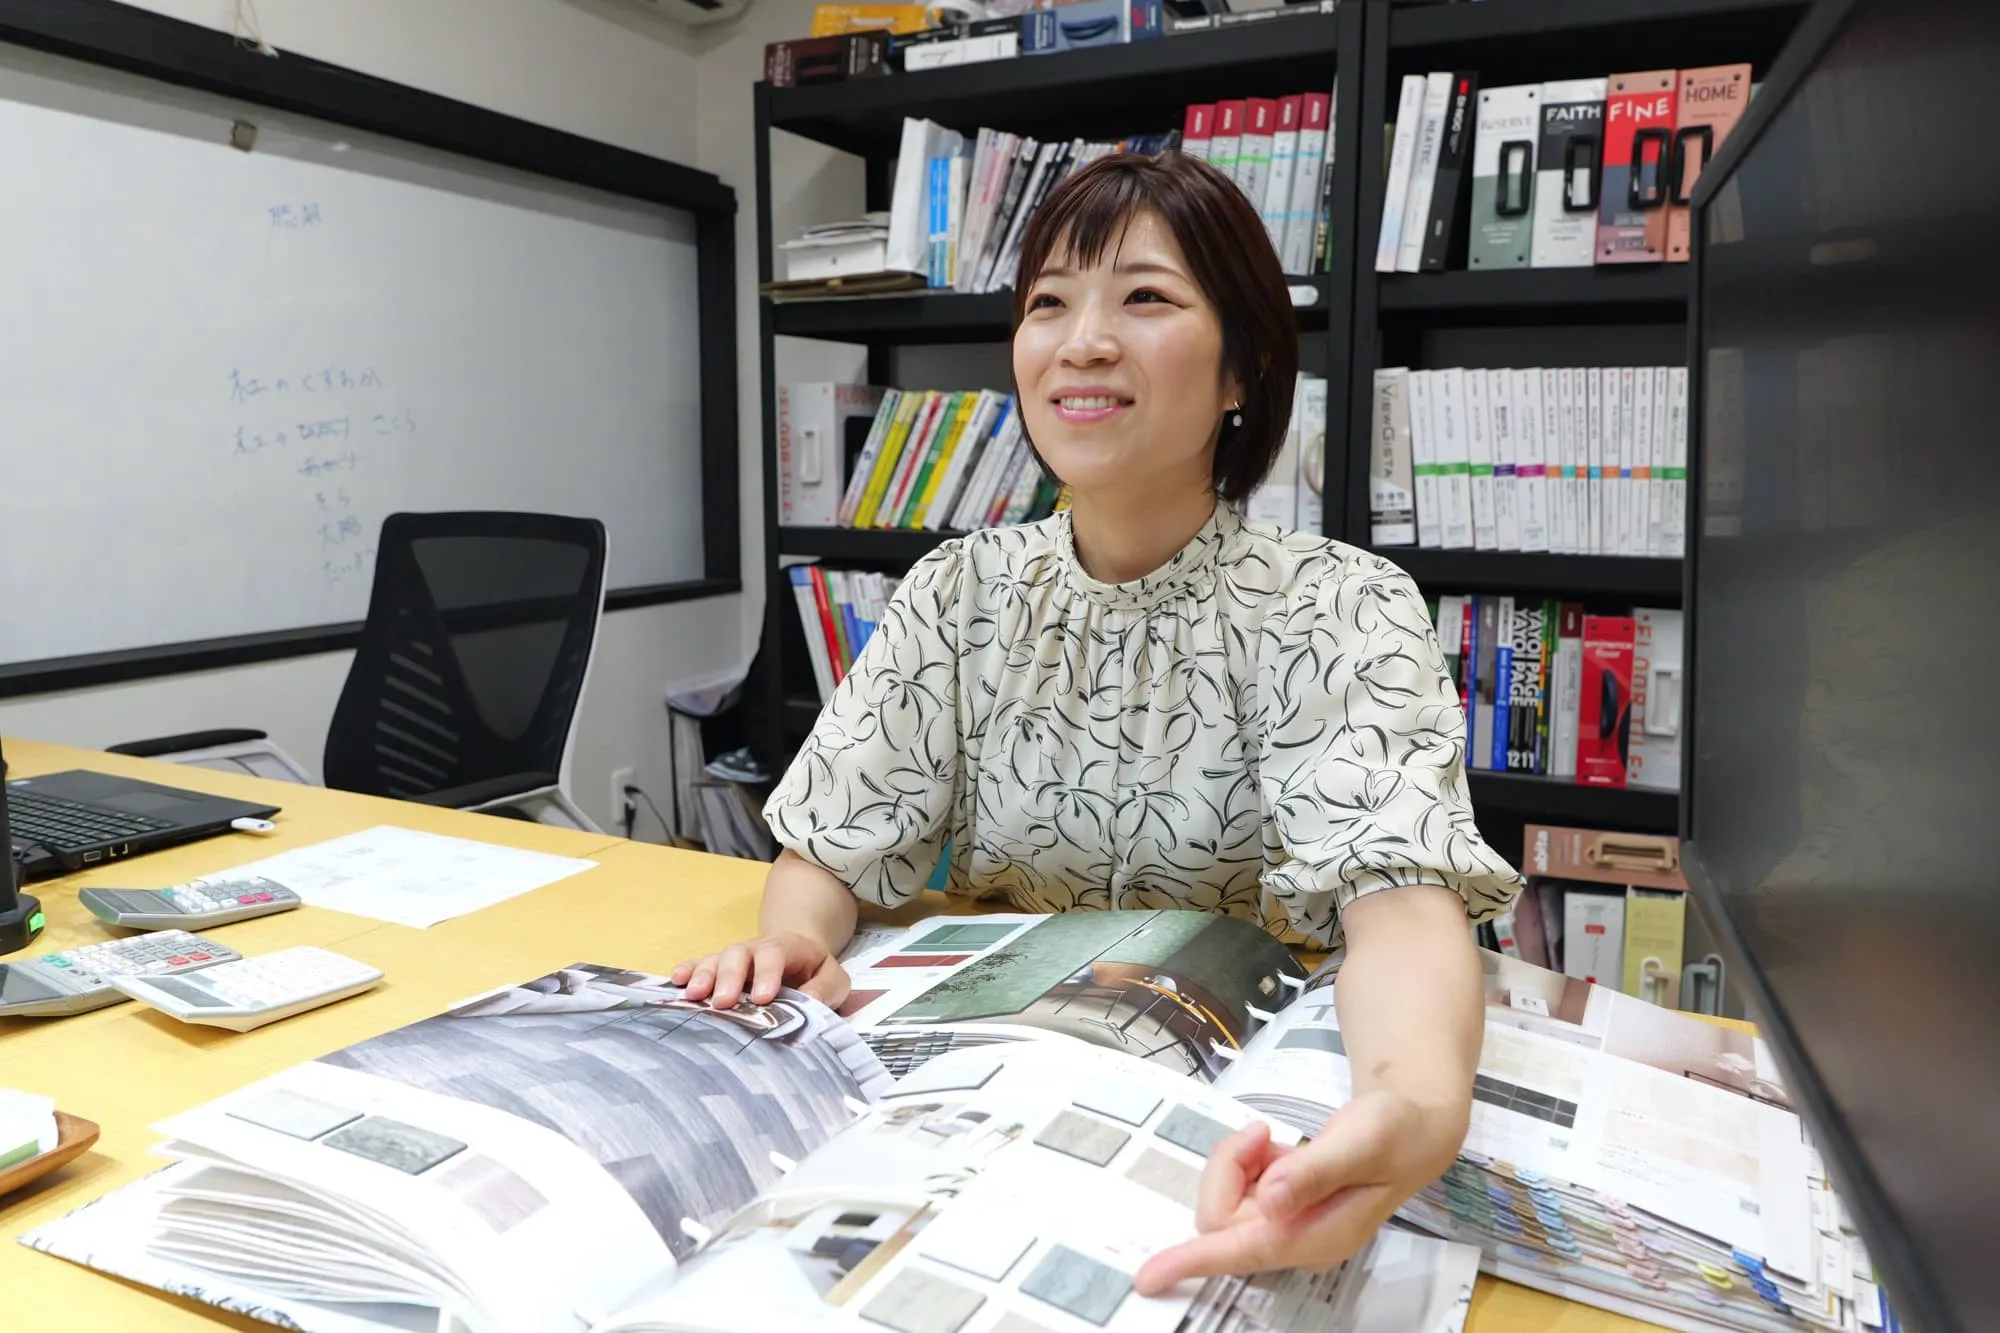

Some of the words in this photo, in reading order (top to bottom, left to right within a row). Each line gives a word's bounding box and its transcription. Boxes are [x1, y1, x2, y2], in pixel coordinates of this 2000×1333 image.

[1546, 105, 1601, 121] FAITH
[1608, 97, 1671, 122] FINE
[1685, 83, 1739, 103] HOME
[1511, 608, 1528, 658] YAYOI
[1526, 608, 1544, 658] YAYOI
[1509, 661, 1526, 707] PAGE
[1524, 661, 1541, 707] PAGE
